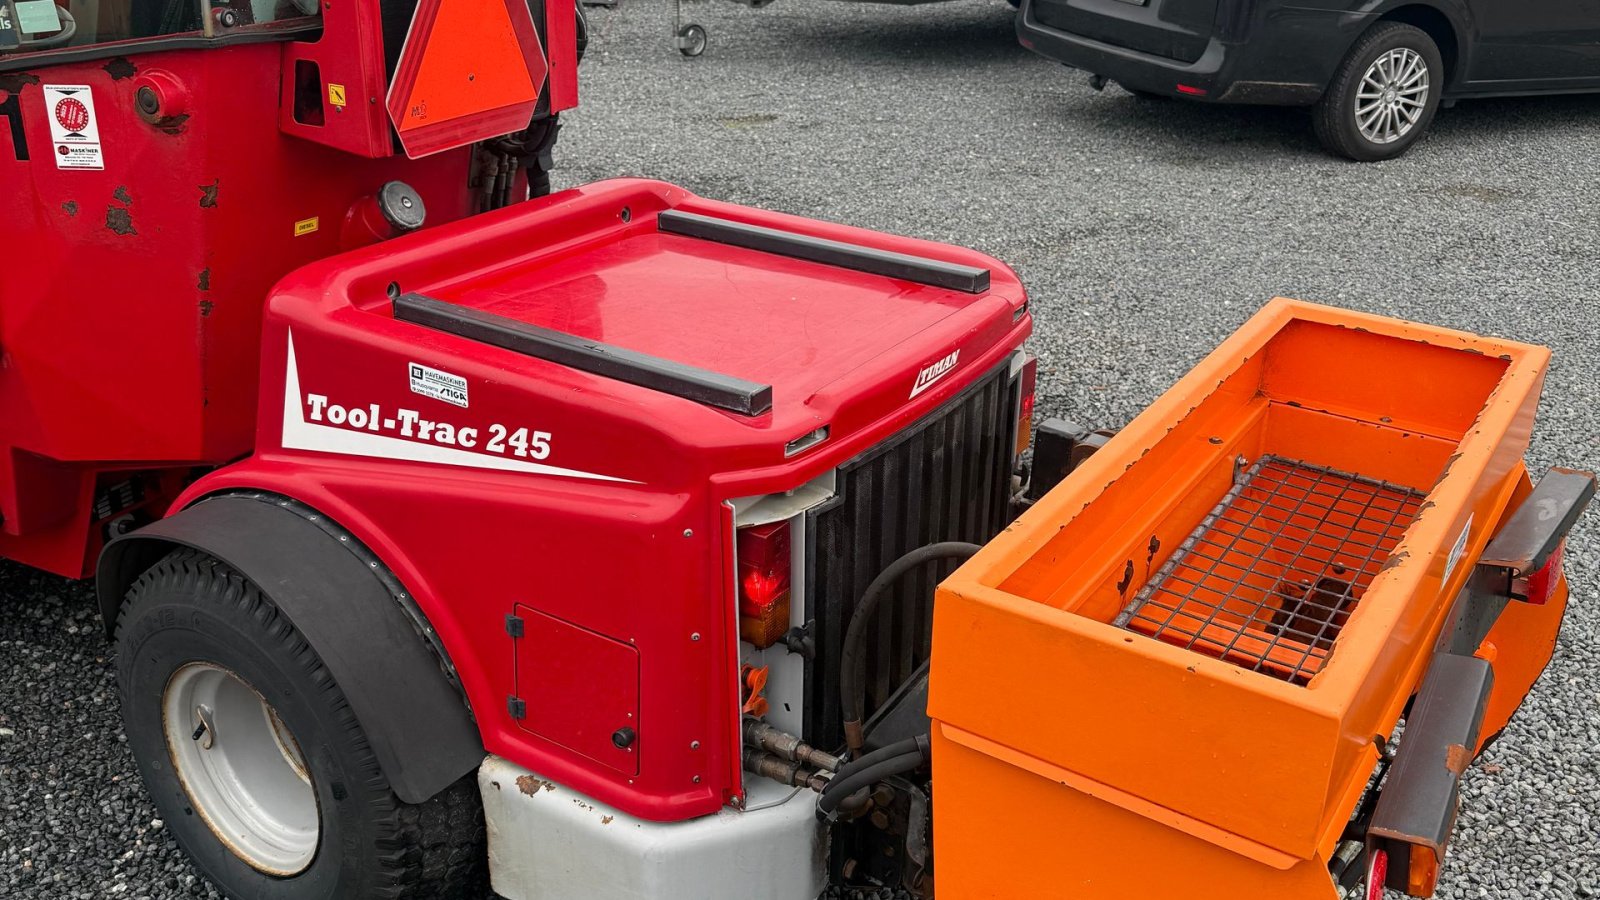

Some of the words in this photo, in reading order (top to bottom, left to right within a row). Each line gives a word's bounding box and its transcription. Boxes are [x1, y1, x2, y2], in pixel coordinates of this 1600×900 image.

[424, 370, 466, 388] HAVEMASKINER
[918, 348, 961, 386] TIMAN
[307, 393, 478, 448] Tool-Trac
[485, 423, 552, 460] 245
